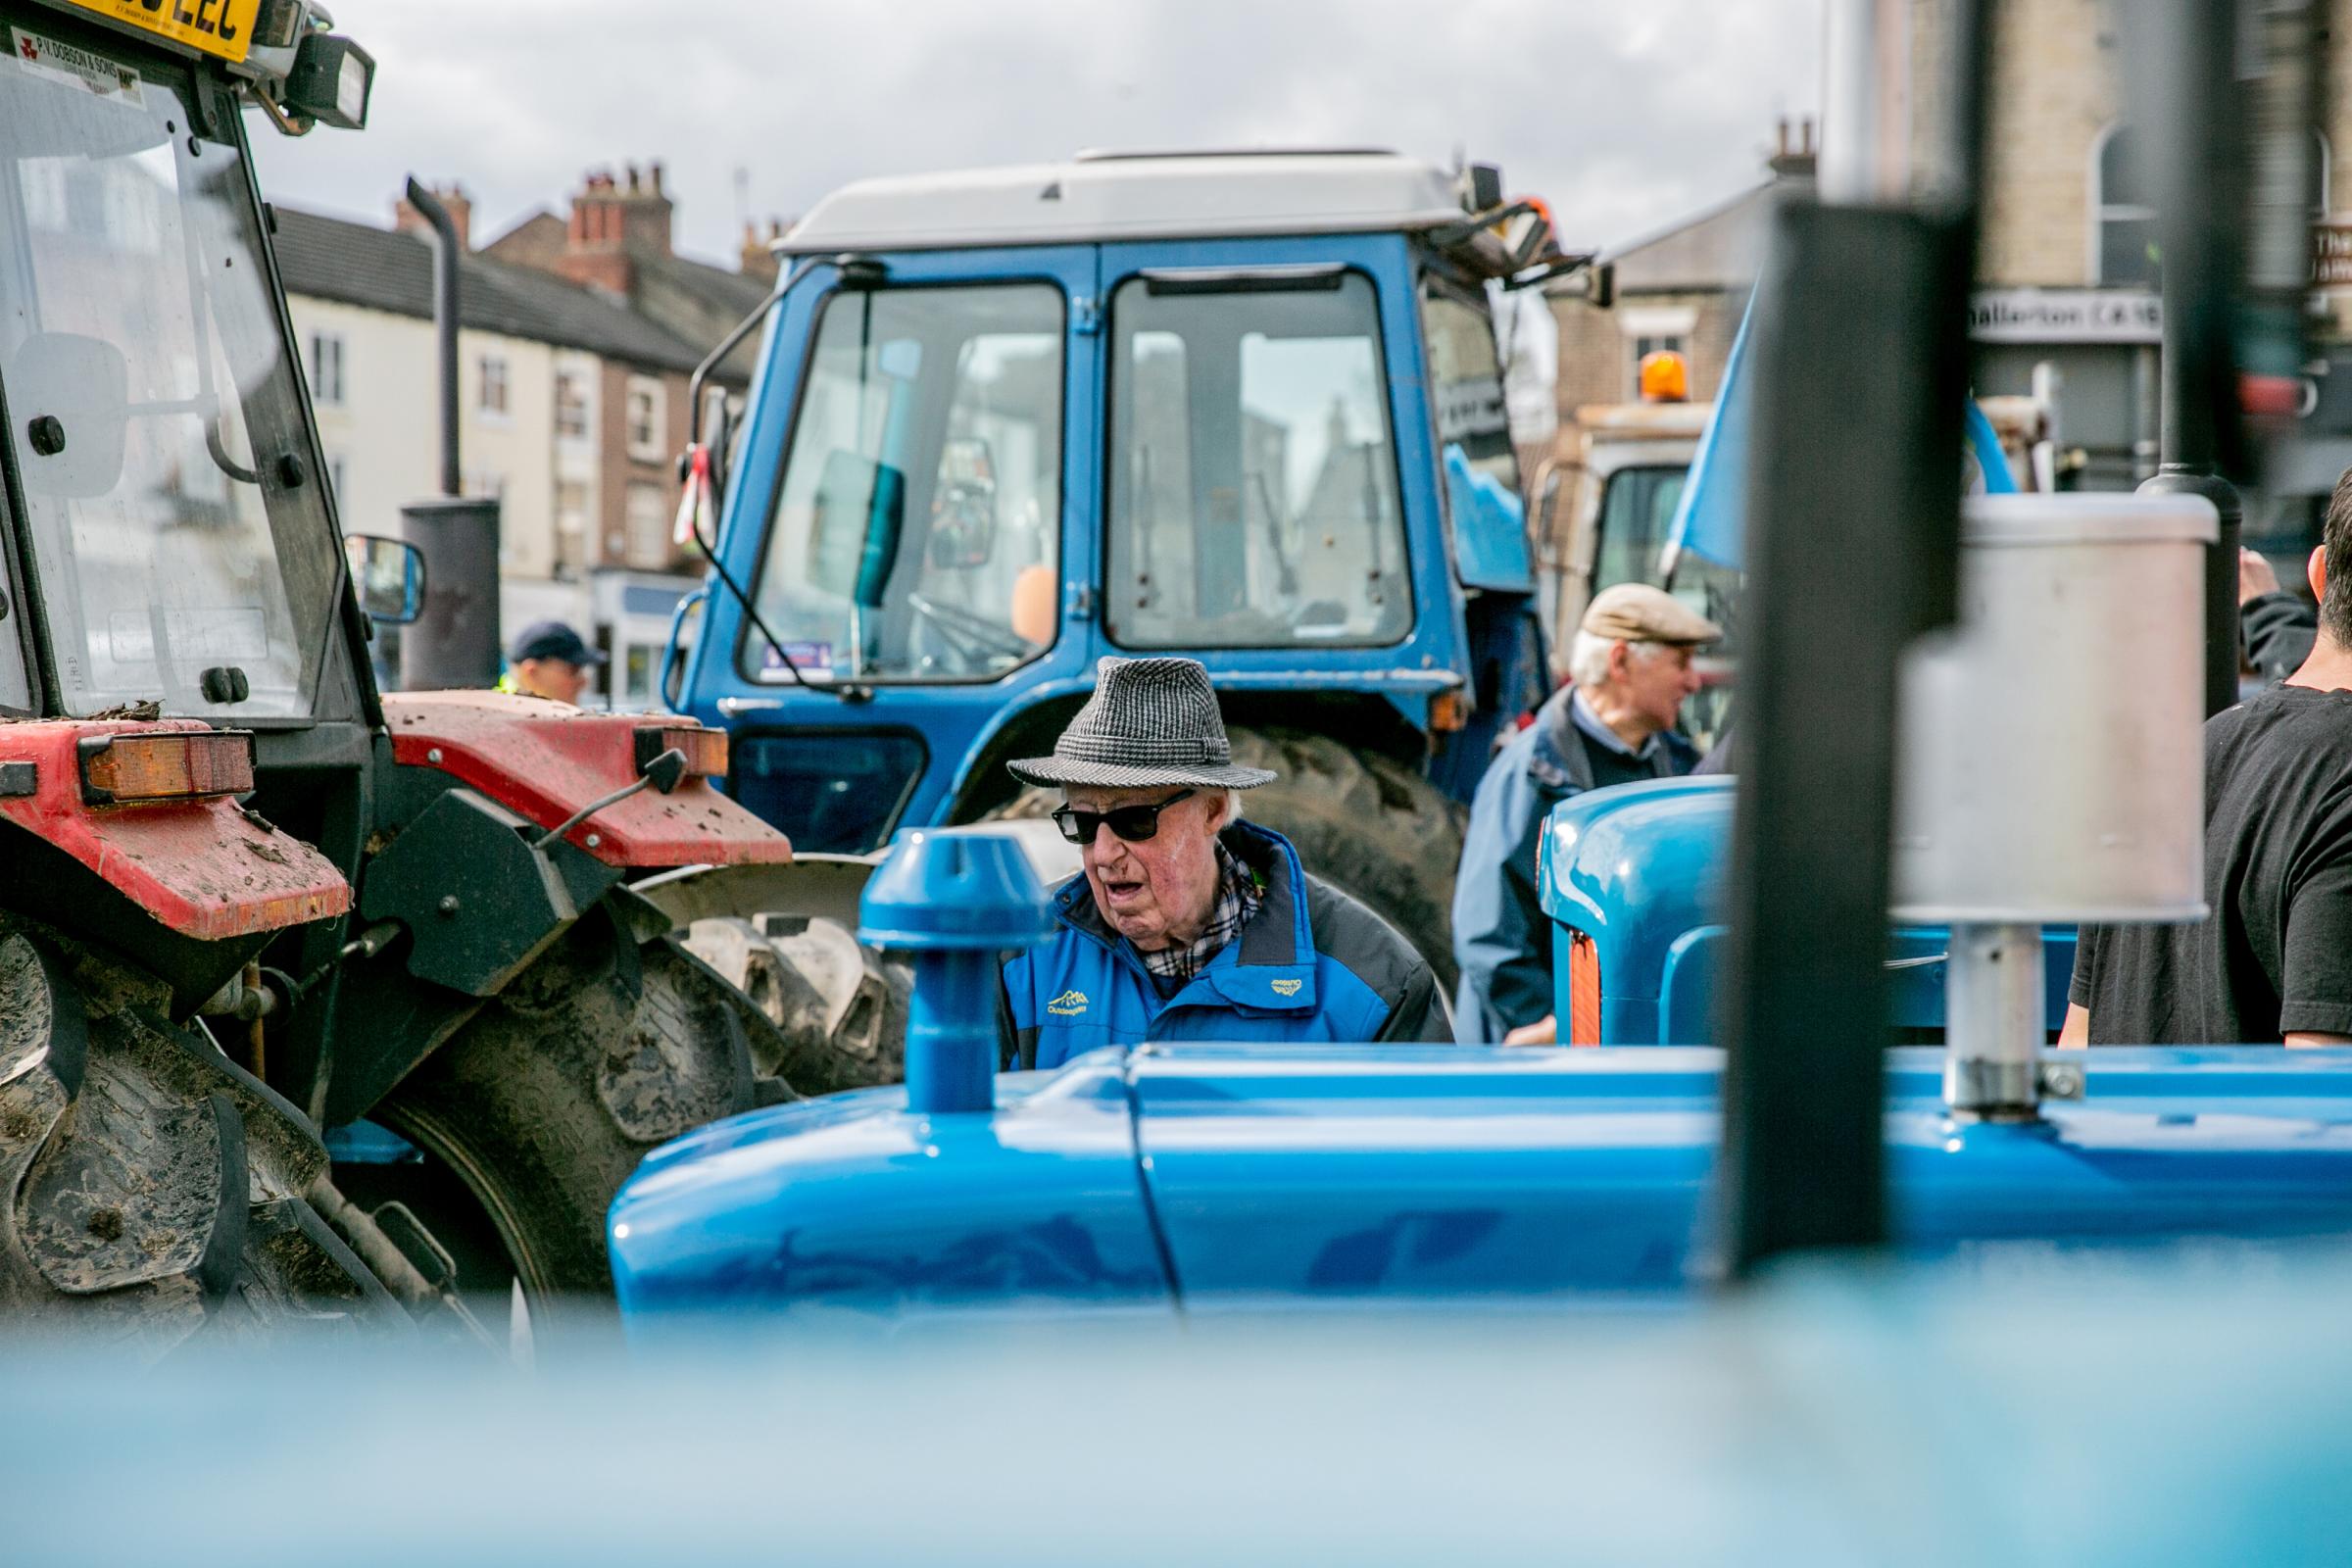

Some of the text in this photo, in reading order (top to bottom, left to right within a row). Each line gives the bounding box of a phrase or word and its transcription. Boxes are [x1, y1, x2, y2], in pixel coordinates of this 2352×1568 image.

[52, 42, 87, 70] DOBSON
[87, 58, 95, 71] &
[94, 58, 117, 78] SONS
